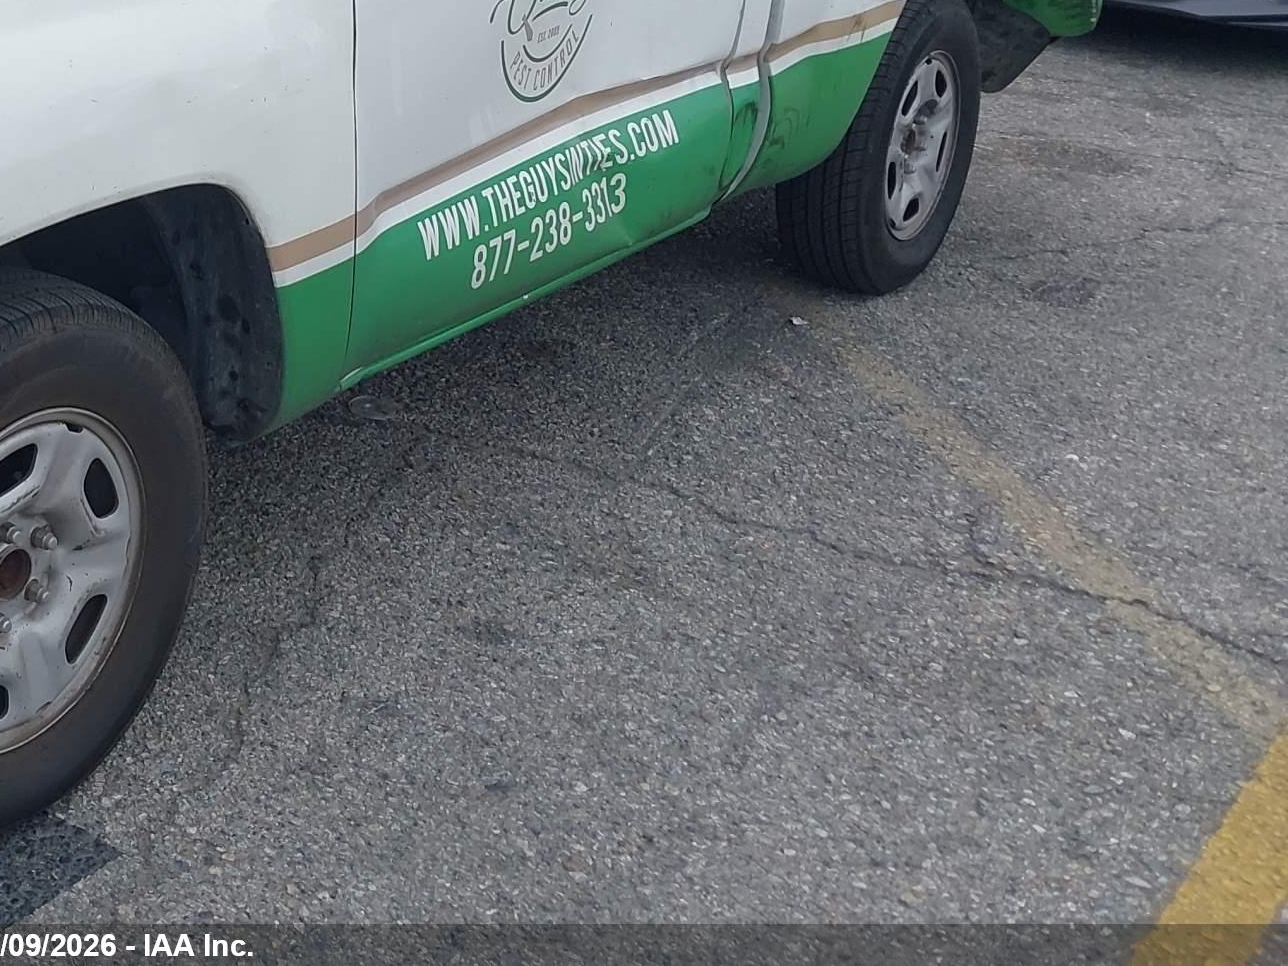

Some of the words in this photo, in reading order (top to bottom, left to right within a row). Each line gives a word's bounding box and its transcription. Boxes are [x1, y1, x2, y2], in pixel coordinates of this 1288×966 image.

[510, 50, 532, 91] PEST
[533, 30, 579, 91] CONTROL
[418, 109, 680, 261] WWW.THEGUYSINTIES.COM
[471, 172, 627, 290] 877-238-3313
